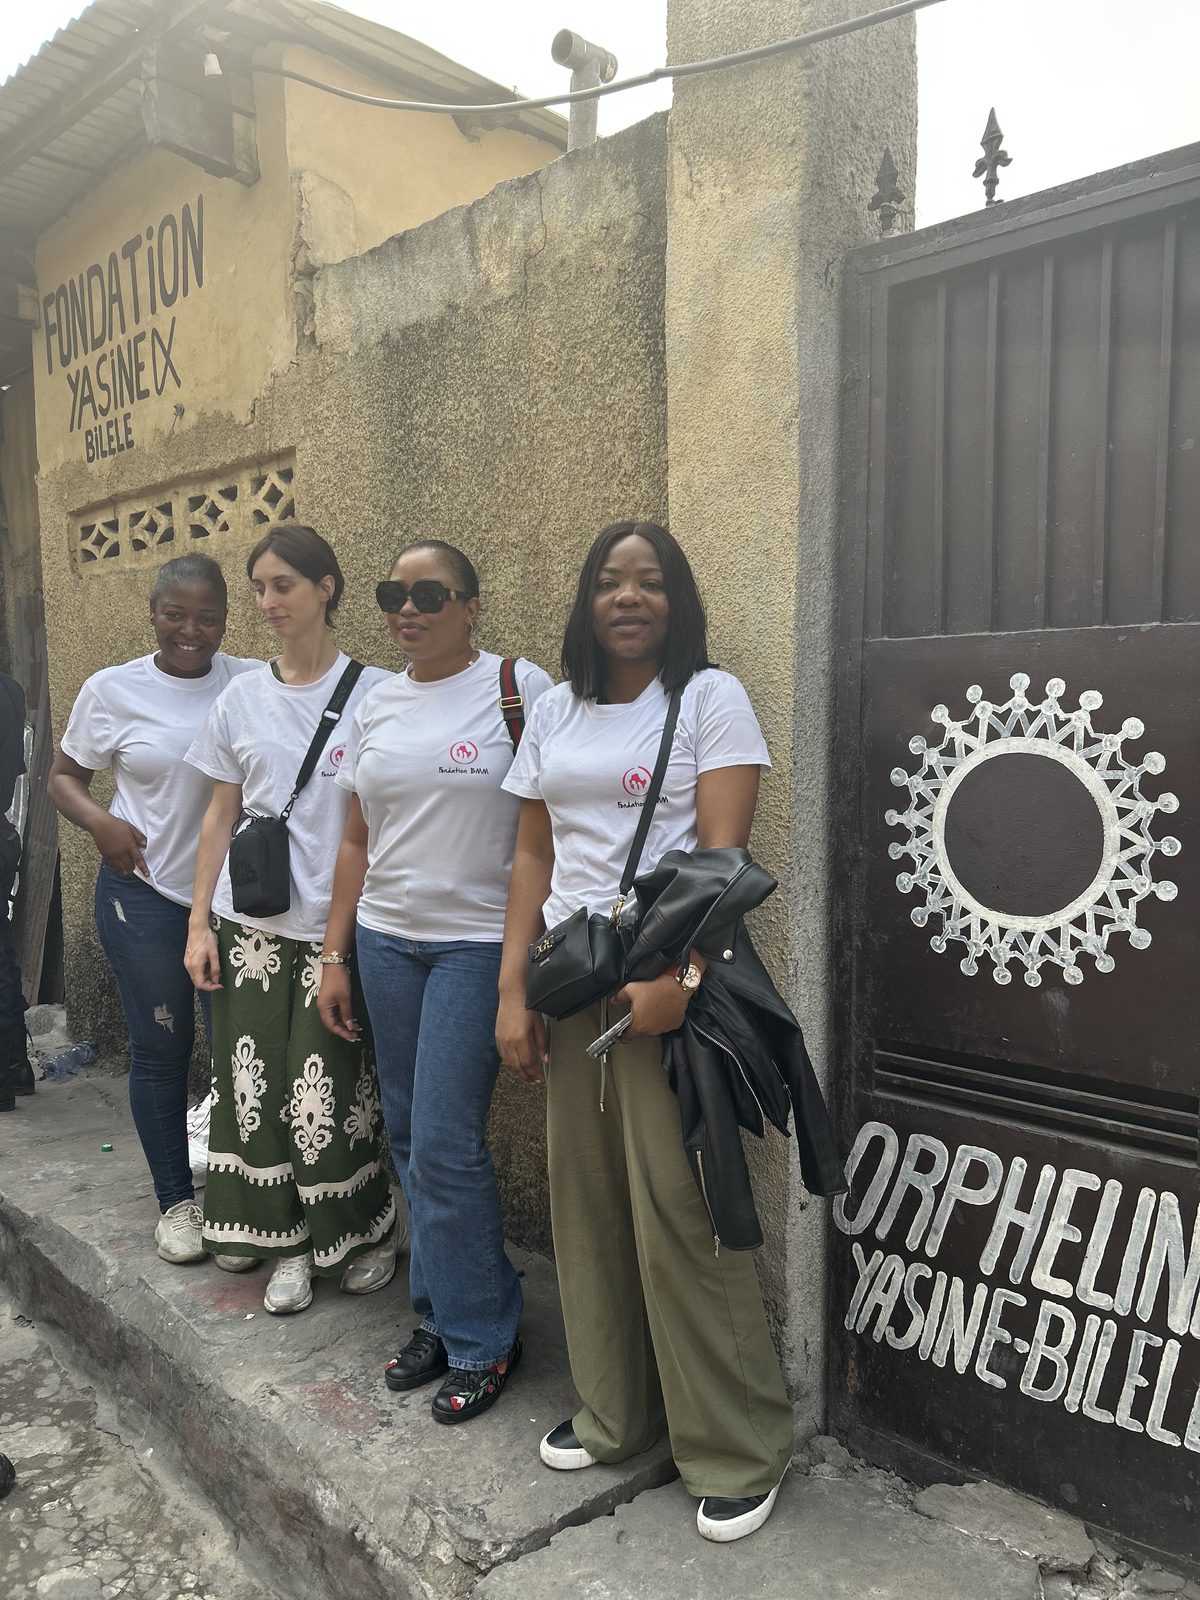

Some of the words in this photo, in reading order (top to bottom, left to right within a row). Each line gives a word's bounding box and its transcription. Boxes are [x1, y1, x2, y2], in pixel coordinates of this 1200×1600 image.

[438, 766, 467, 774] Fondation
[470, 767, 489, 775] BMM
[617, 800, 645, 809] Fondatio
[832, 1121, 1200, 1339] ORPHELIN
[844, 1242, 1200, 1453] YASINE-BILEL
